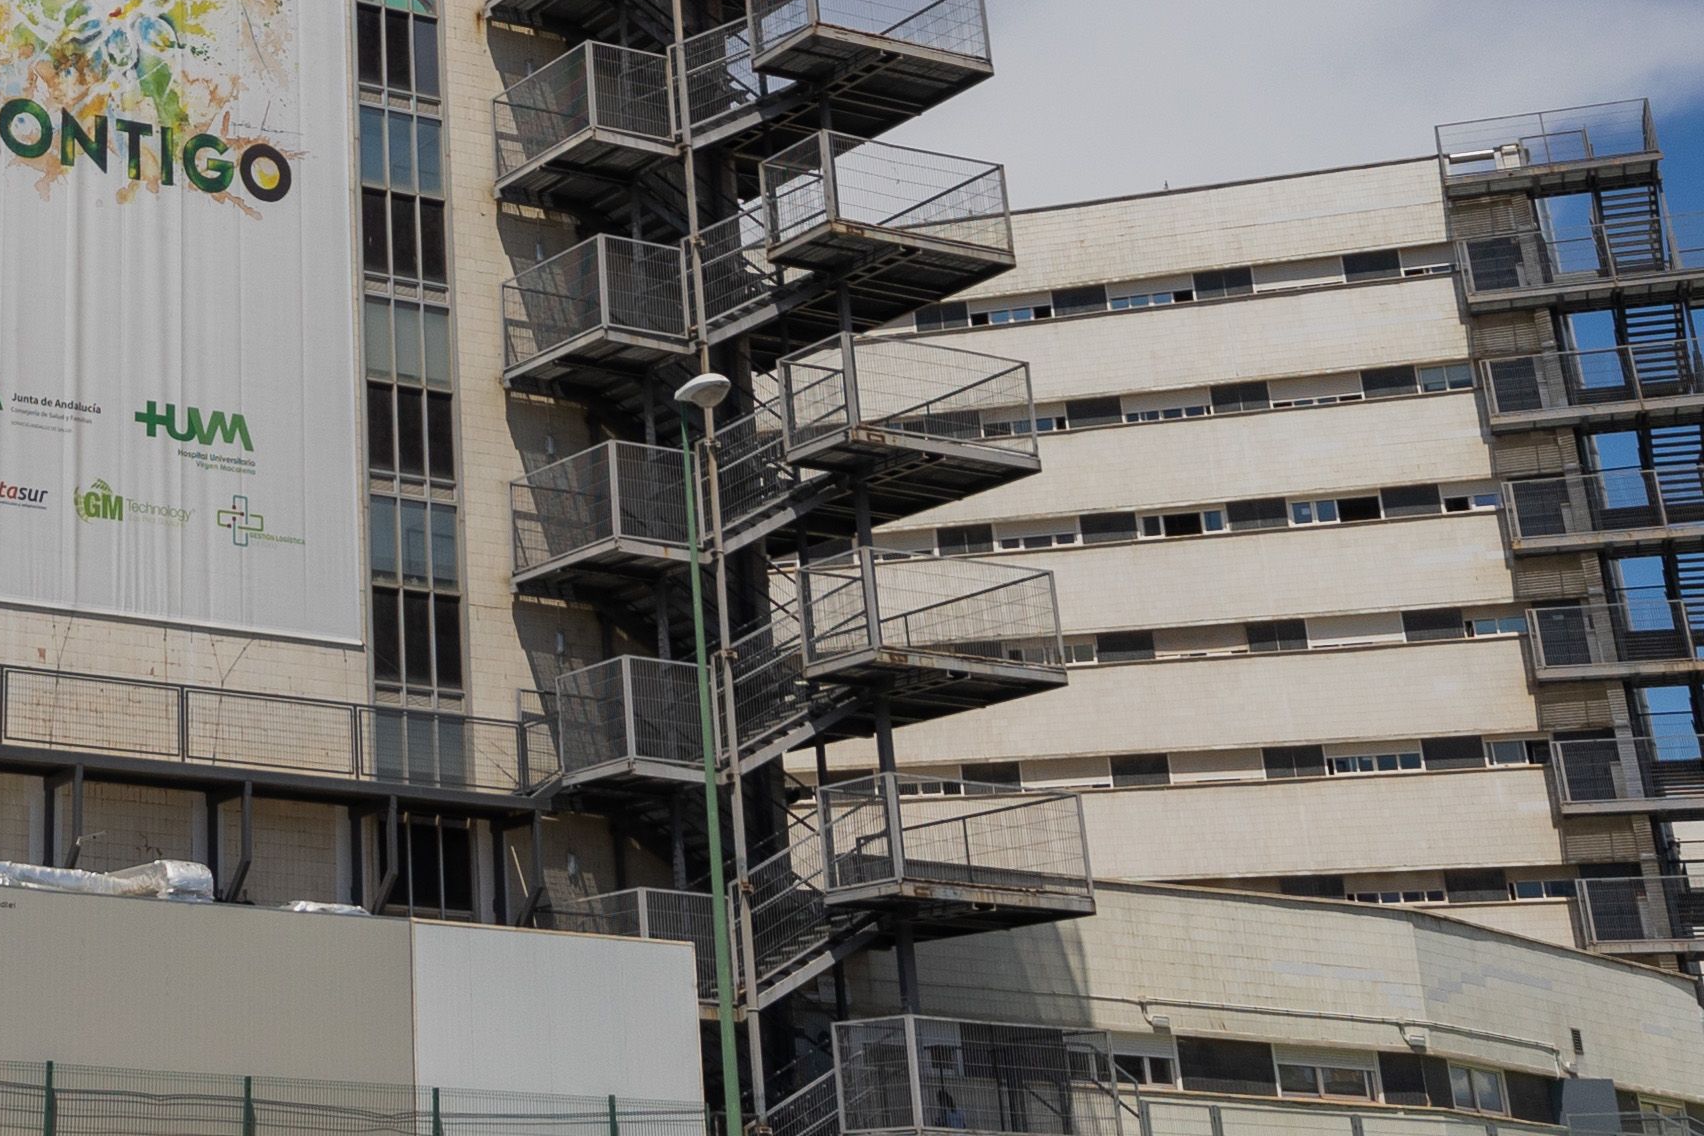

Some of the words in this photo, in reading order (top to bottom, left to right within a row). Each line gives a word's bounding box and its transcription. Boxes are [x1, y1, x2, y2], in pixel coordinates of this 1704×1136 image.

[11, 392, 39, 406] Junta
[40, 397, 53, 407] de
[54, 399, 102, 415] Andalucía
[177, 448, 209, 461] Hospital
[83, 490, 124, 522] GM
[125, 497, 192, 522] Technology
